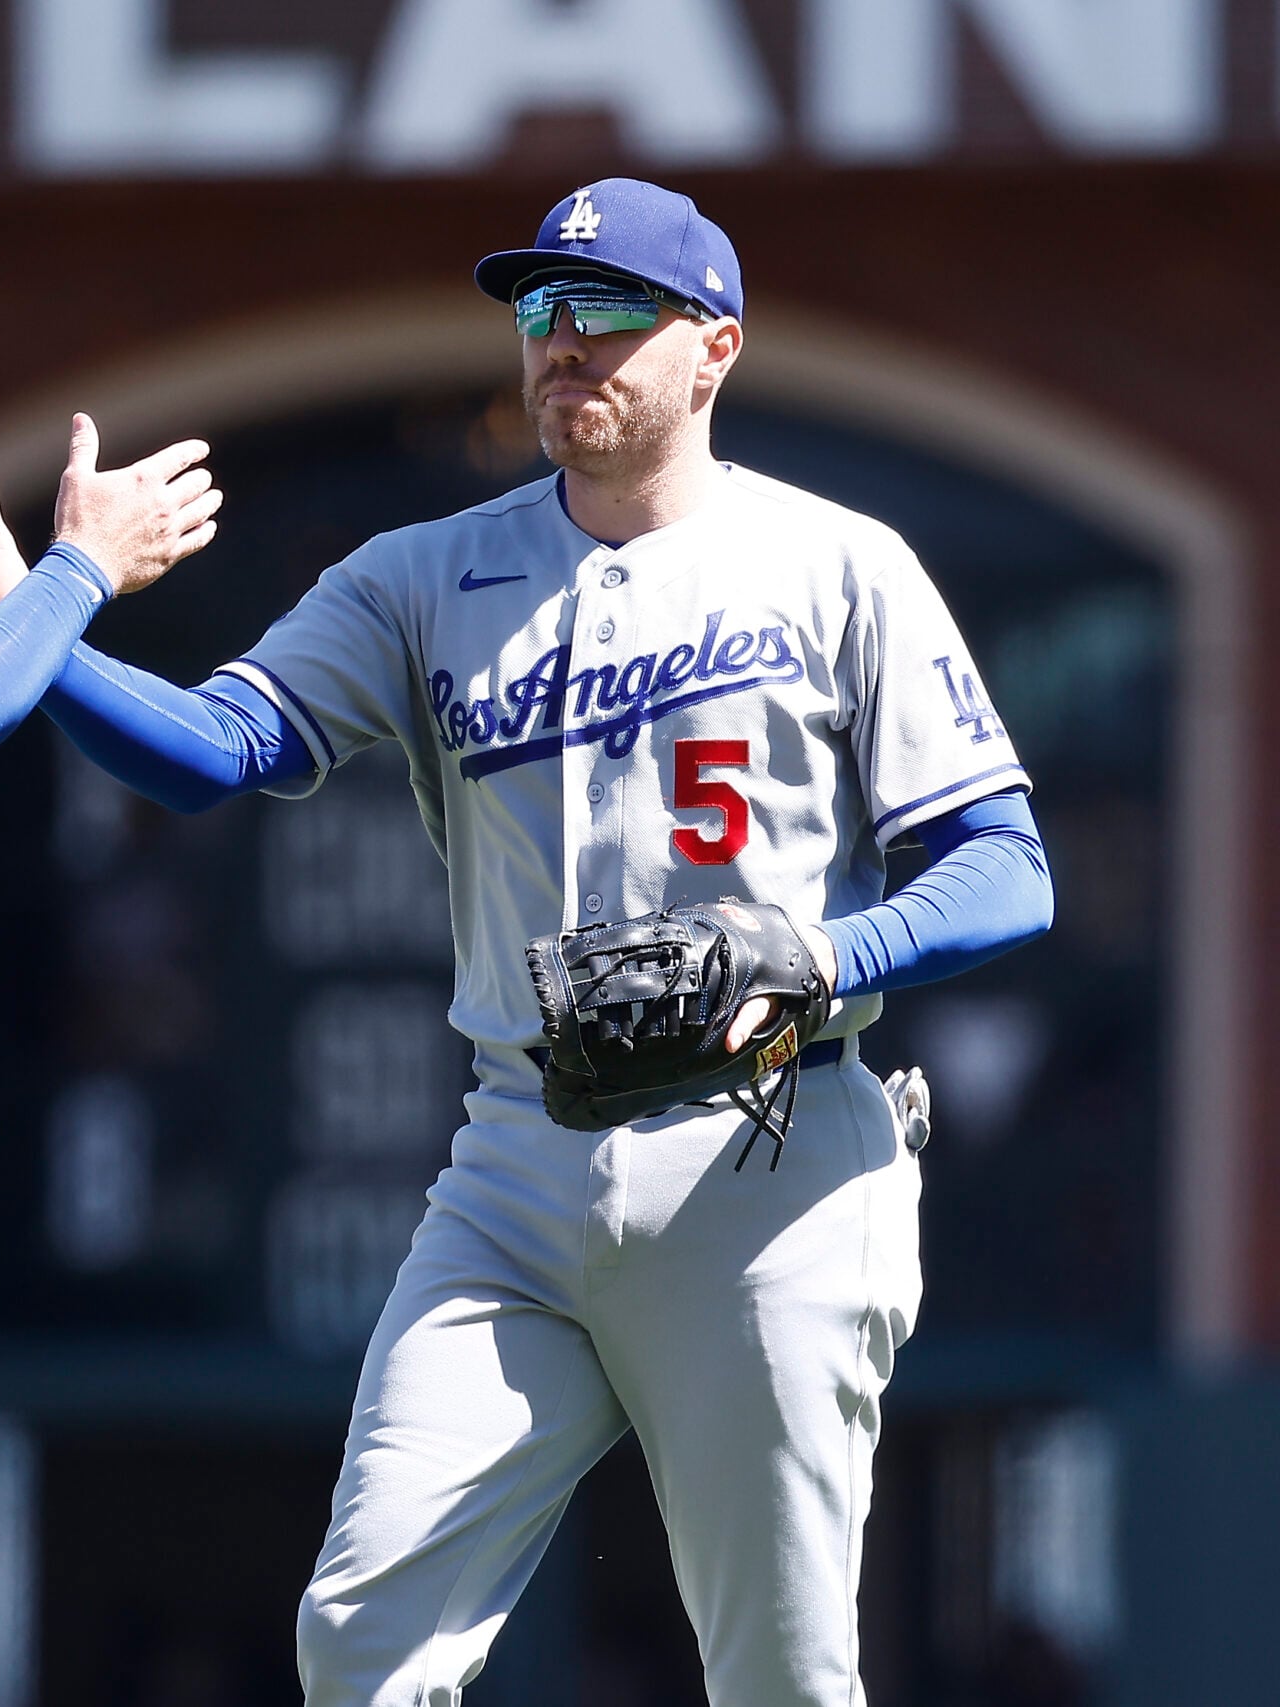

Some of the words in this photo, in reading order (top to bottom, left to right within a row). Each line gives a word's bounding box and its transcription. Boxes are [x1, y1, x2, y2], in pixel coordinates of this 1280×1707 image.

[14, 0, 1280, 174] LAN
[560, 190, 601, 240] LA
[427, 669, 498, 752] Los
[499, 608, 804, 759] Angeles
[932, 655, 1005, 745] LA
[673, 739, 750, 866] 5
